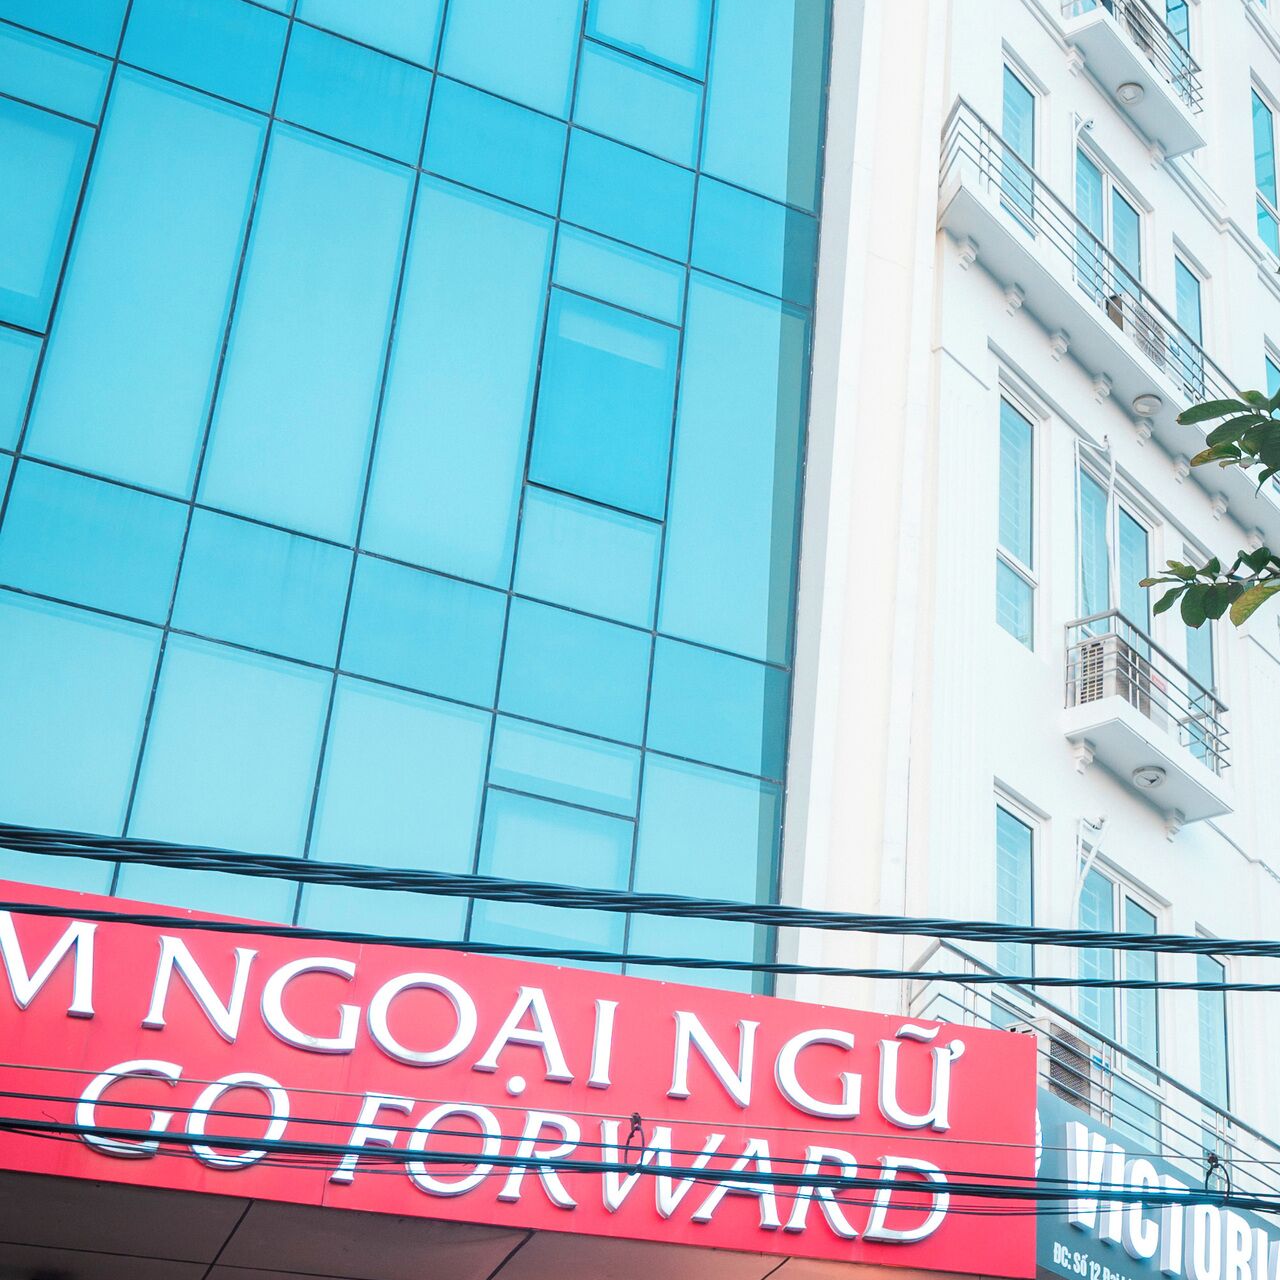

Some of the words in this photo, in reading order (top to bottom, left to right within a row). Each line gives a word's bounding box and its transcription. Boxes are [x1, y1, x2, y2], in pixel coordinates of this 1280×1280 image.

[142, 935, 620, 1097] NGOẠI
[666, 1010, 966, 1133] NGỮ
[75, 1059, 291, 1171] GO
[329, 1091, 951, 1244] FORWARD
[1073, 1252, 1088, 1277] Số
